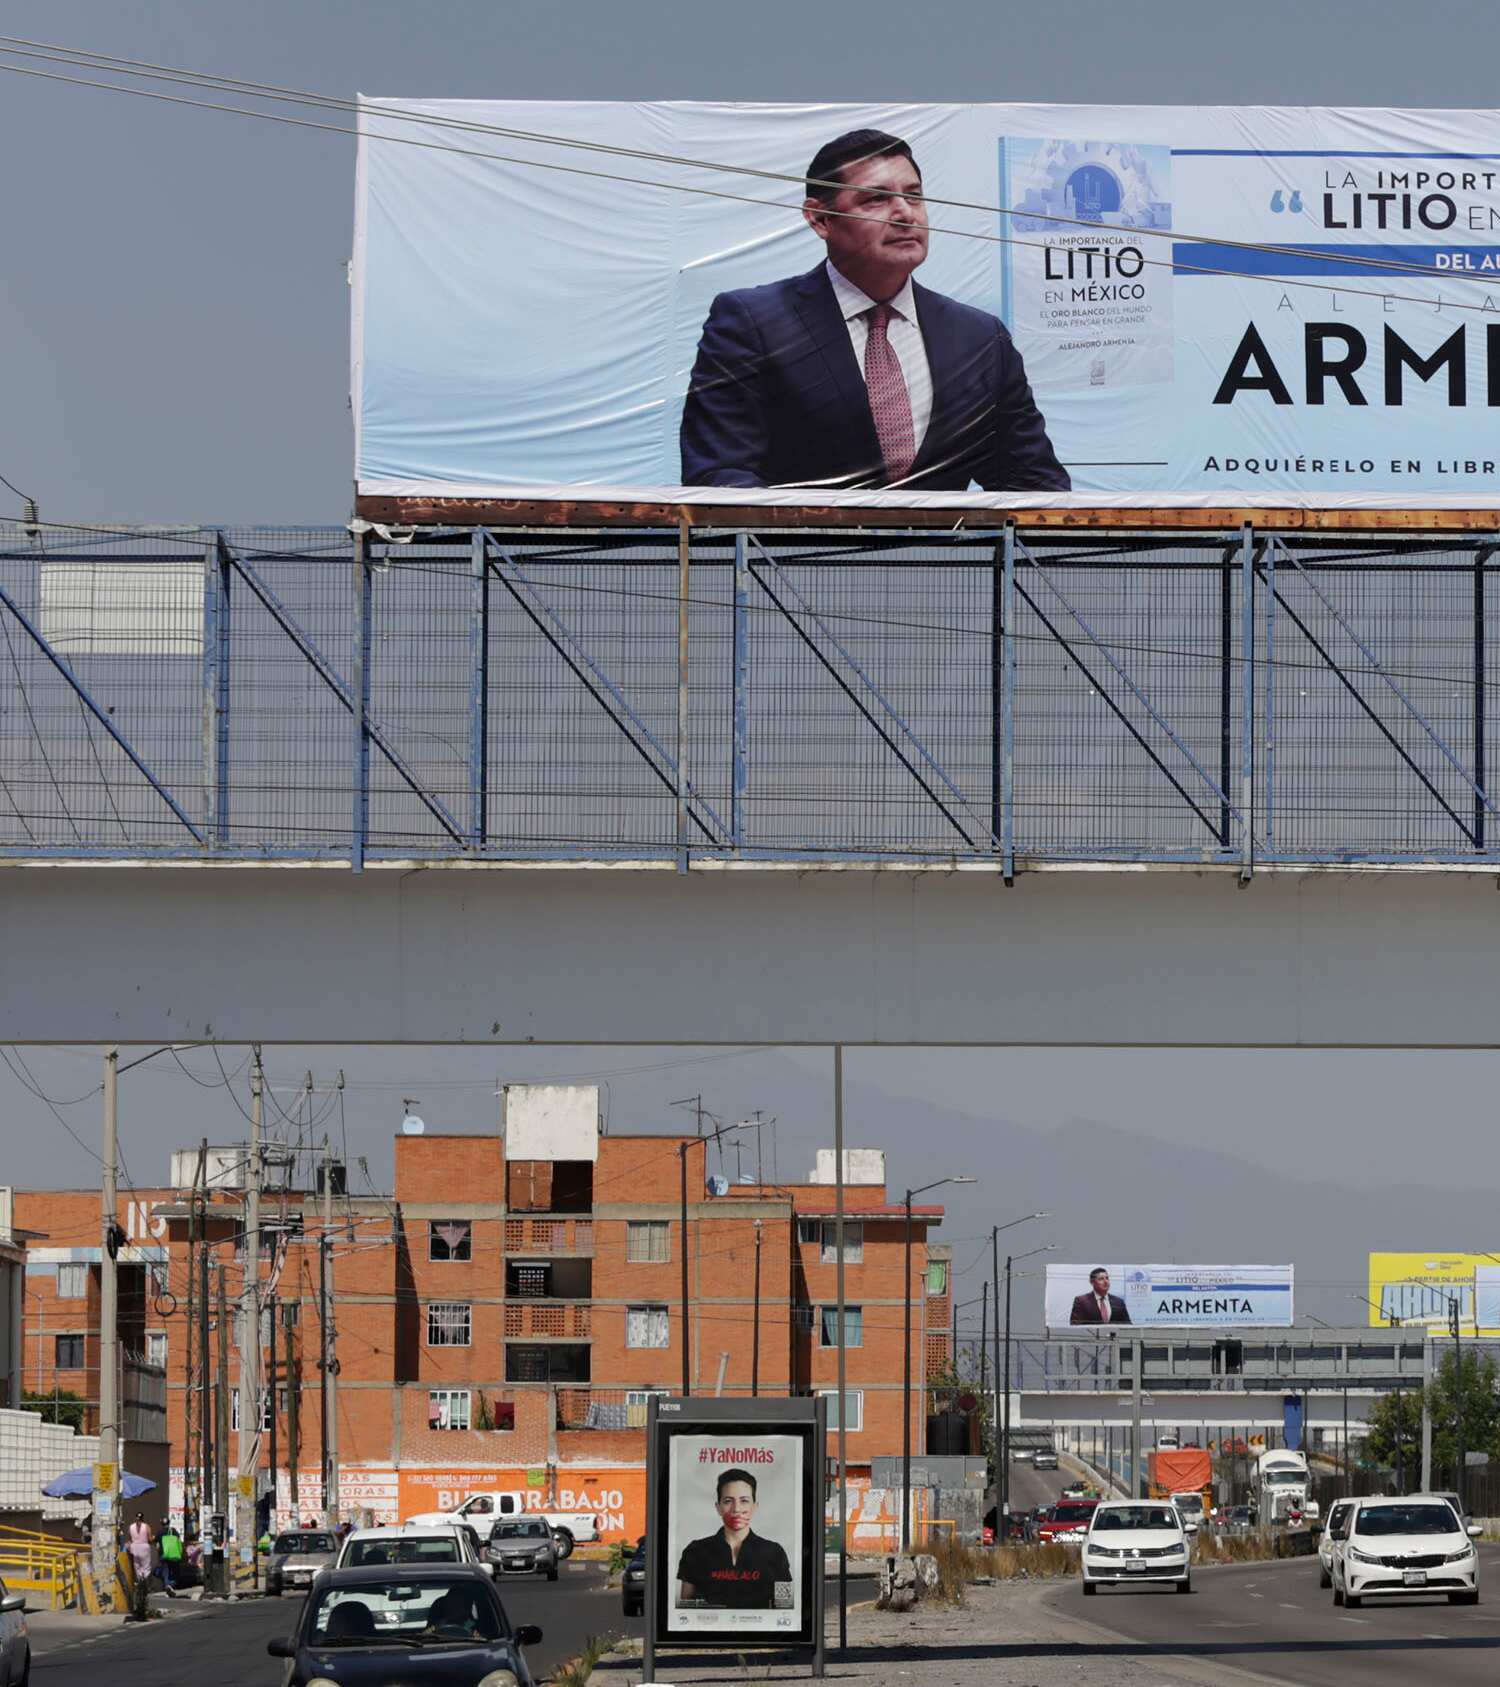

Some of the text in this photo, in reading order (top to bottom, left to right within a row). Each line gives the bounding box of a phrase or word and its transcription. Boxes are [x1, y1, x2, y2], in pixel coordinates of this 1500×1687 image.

[1325, 171, 1358, 189] LA
[1323, 192, 1457, 230] LITIO
[1060, 236, 1123, 245] IMPORTANCIA
[1045, 246, 1144, 280] LITIO
[1435, 253, 1476, 270] DEL
[1045, 281, 1145, 303] EN MÉXICO
[1051, 310, 1070, 318] ORO
[1072, 308, 1105, 317] BLANCO
[1058, 341, 1101, 350] ALEJANDRO
[1203, 454, 1376, 474] ADQUIÉRELO
[1391, 459, 1422, 474] EN
[1157, 1298, 1253, 1314] ARMENTA
[699, 1447, 774, 1464] #YaNoMás
[520, 1490, 623, 1509] RABAJO
